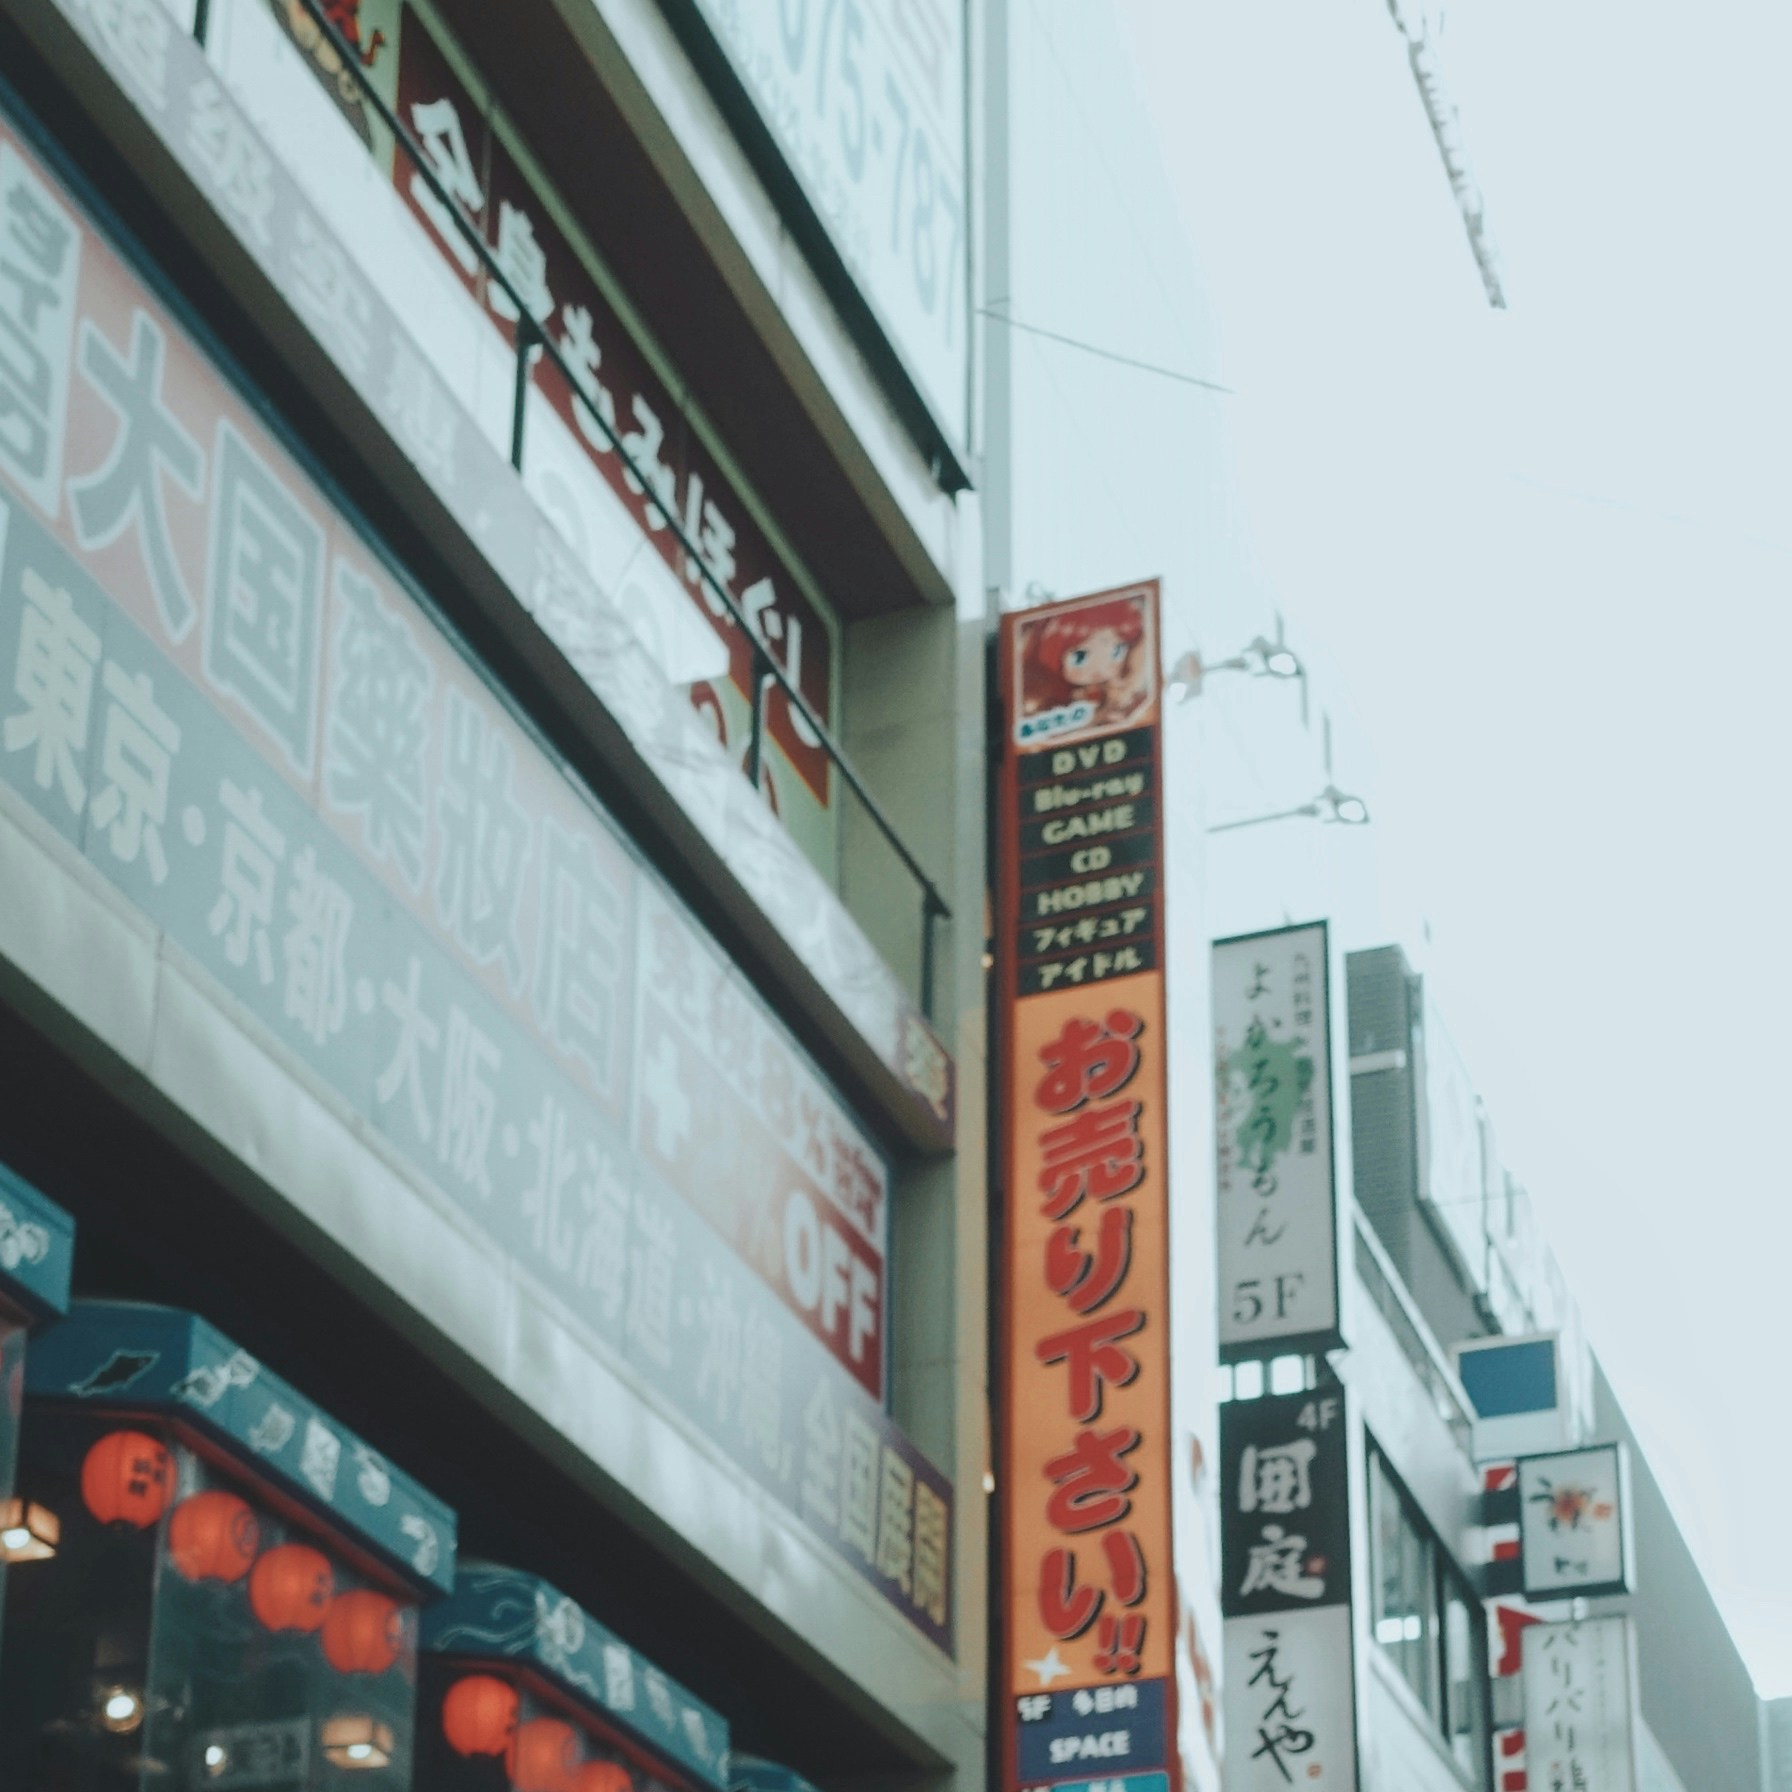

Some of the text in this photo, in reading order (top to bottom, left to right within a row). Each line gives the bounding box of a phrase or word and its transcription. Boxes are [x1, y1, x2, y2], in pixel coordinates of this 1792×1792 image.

[1051, 739, 1128, 777] DVD
[1033, 770, 1145, 813] Blu-ray
[1041, 804, 1137, 847] GAME
[1070, 845, 1113, 874] CD
[1037, 872, 1145, 917] HOBBY
[1037, 945, 1144, 989] アイドル
[1232, 1274, 1305, 1326] 5F
[1296, 1399, 1337, 1431] 4F
[1048, 1731, 1131, 1765] SPACE
